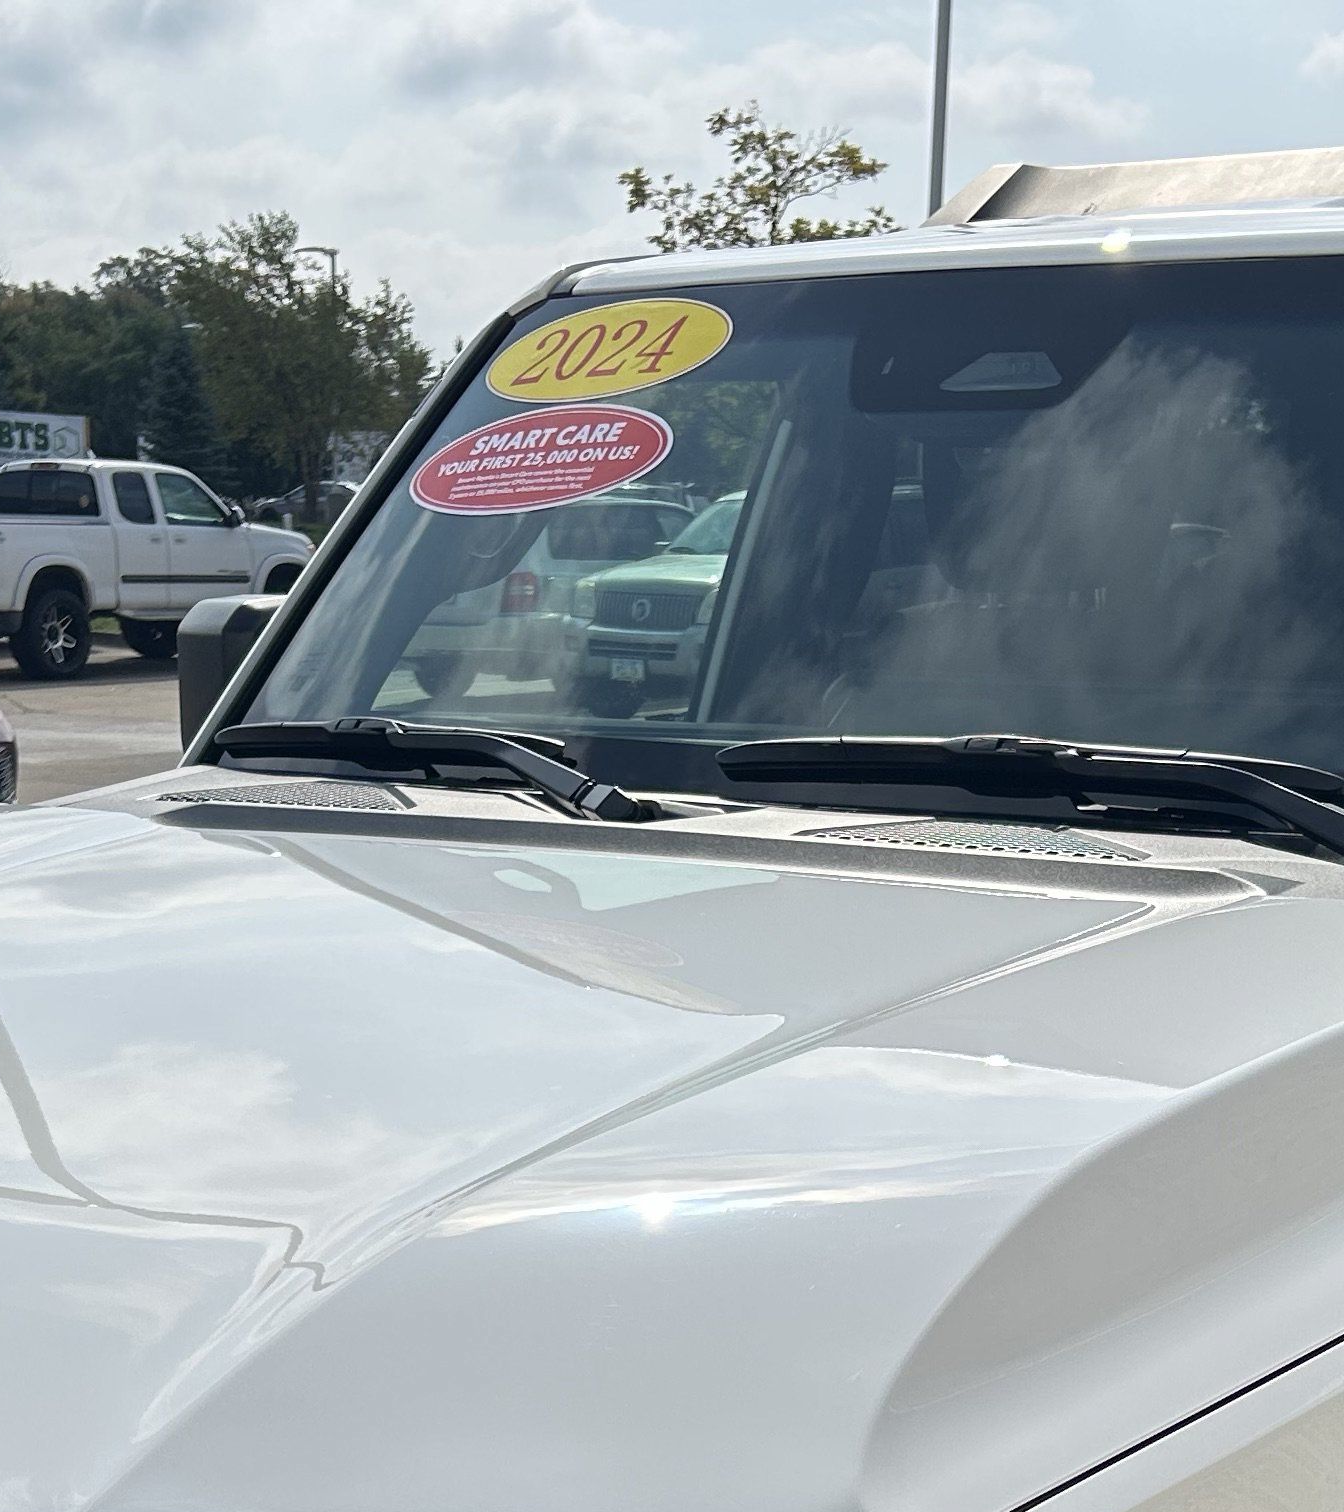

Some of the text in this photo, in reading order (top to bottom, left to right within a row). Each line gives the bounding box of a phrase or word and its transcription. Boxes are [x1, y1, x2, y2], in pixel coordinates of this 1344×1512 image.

[509, 314, 689, 387] 2024
[469, 421, 627, 456] SMART CARE
[437, 445, 640, 478] YOUR FIRST 25,000 ON US!
